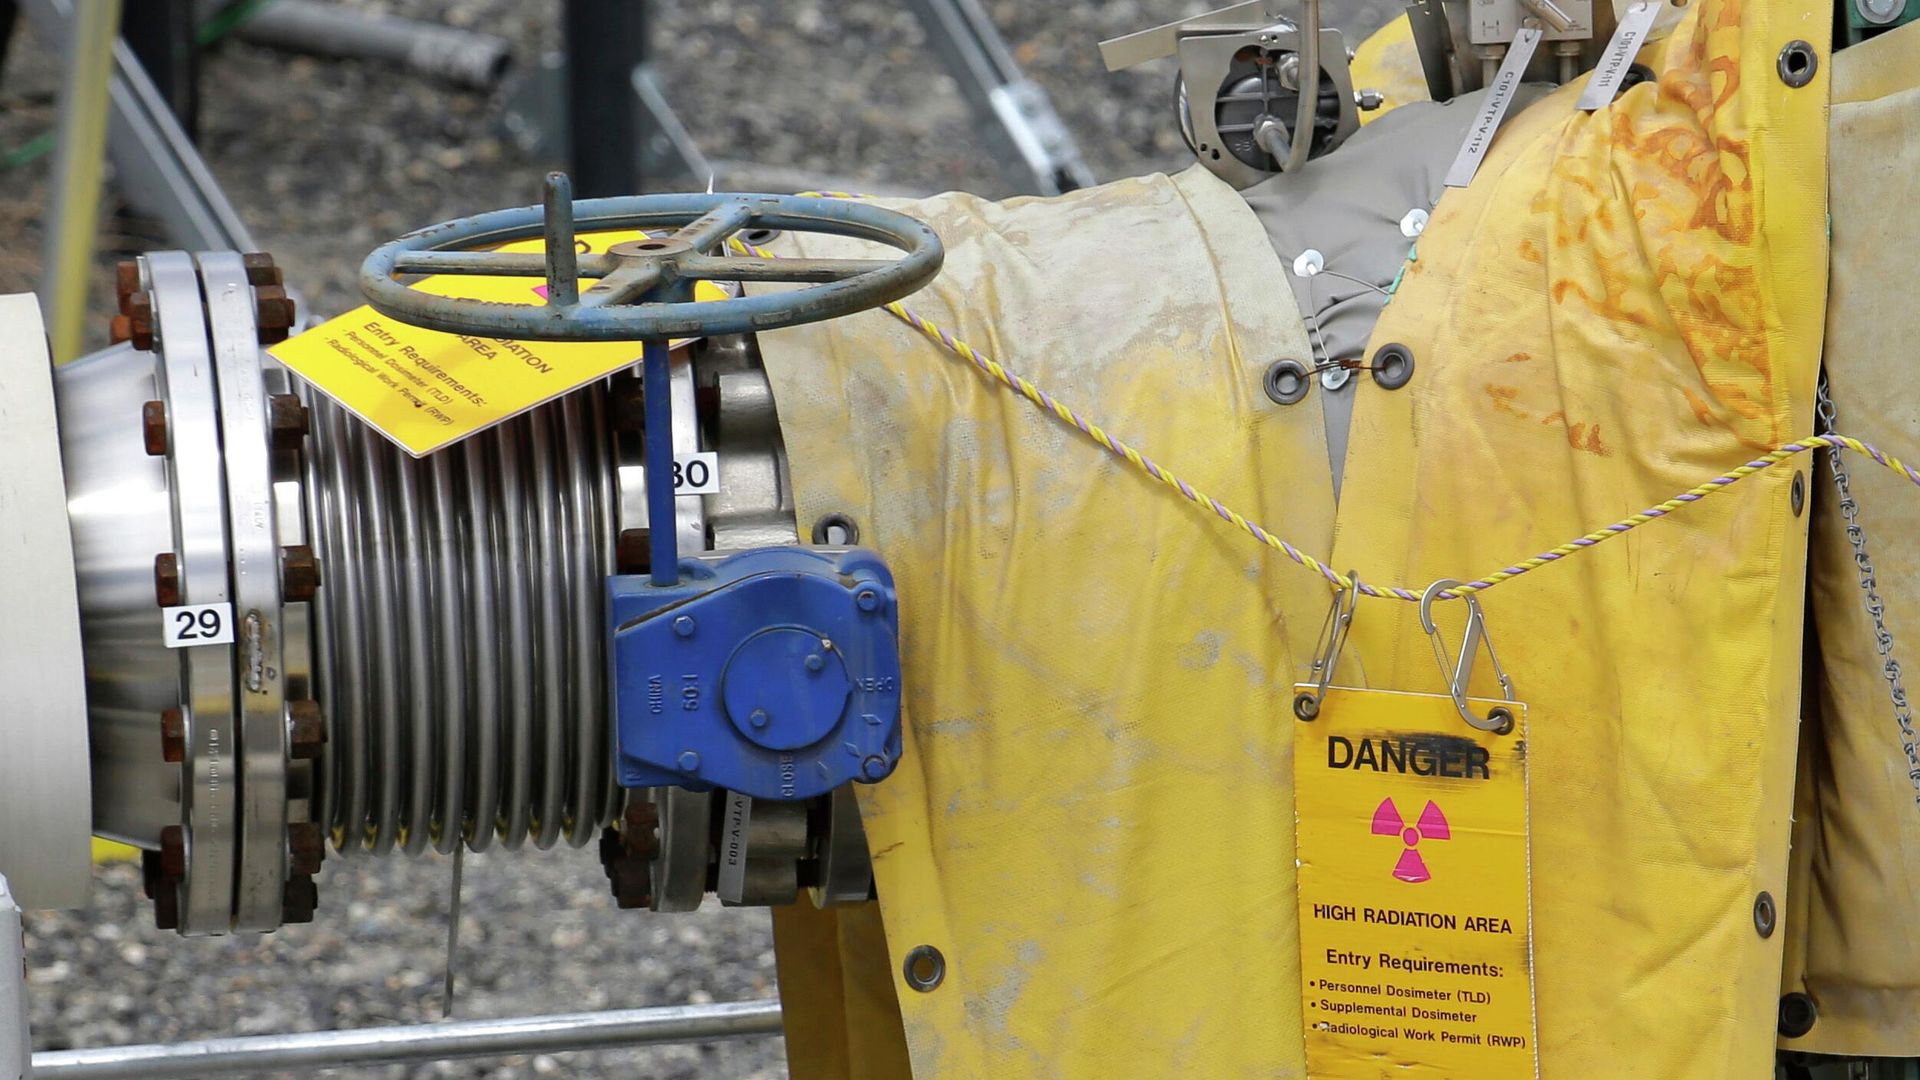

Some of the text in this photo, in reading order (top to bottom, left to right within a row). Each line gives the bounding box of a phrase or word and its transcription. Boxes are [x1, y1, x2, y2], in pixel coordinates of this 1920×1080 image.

[1597, 31, 1637, 87] C101-VTP-V-111
[1468, 71, 1514, 153] C101-VTP-V-112
[345, 331, 387, 359] Personnel
[428, 387, 453, 406] (TLD)
[363, 322, 487, 407] Entry Requirements:
[327, 339, 379, 374] Radiological
[377, 372, 399, 388] Work
[424, 406, 454, 426] (RWP)
[176, 609, 220, 639] 29
[855, 676, 893, 692] OPEN
[1328, 736, 1490, 779] DANGER
[1313, 904, 1512, 934] HIGH RADIATION AREA
[1326, 949, 1504, 978] Entry Requirements:
[1319, 979, 1491, 1005] Personnel Dosimeter (TLD)
[1320, 999, 1477, 1023] Supplemental Dosimeter
[1403, 1028, 1435, 1041] Work
[1441, 1031, 1481, 1045] Permit
[1487, 1034, 1526, 1049] (RWP)
